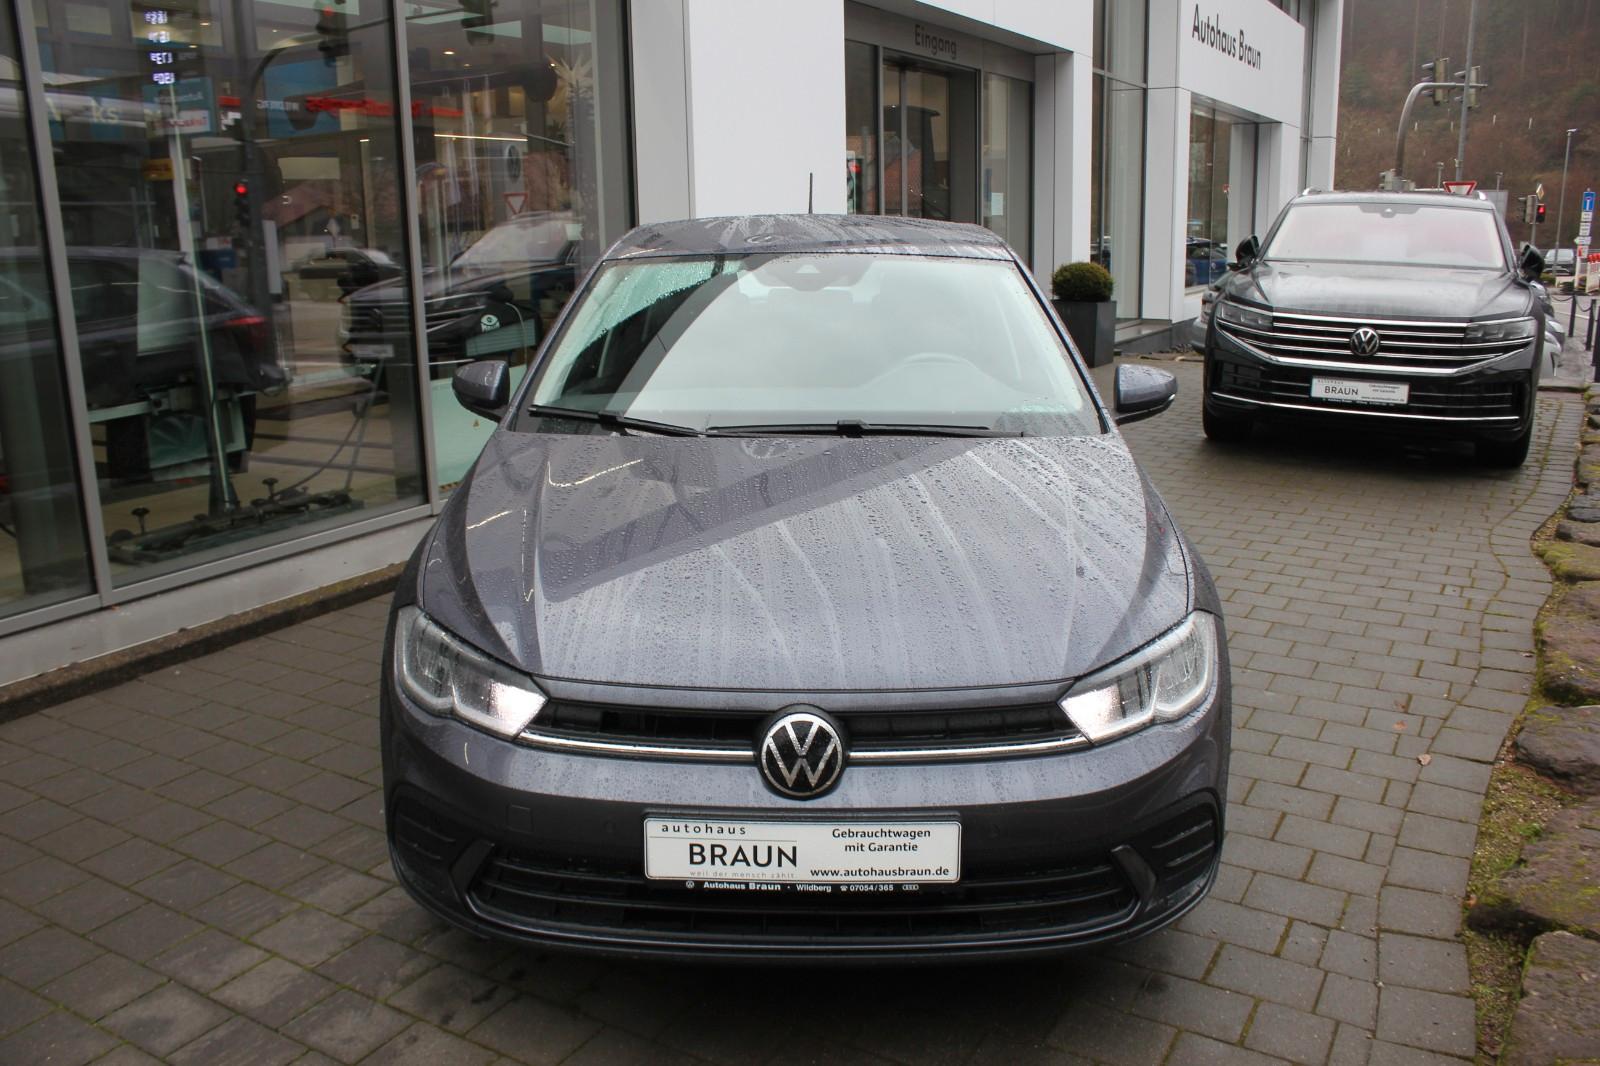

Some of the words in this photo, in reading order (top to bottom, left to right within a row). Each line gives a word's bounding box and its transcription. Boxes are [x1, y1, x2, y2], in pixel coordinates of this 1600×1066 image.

[915, 24, 957, 60] Eingang
[1192, 3, 1236, 58] Autohaus
[1239, 29, 1261, 70] Braun
[1324, 386, 1359, 395] BRAUN
[661, 823, 747, 835] autohaus
[832, 828, 931, 840] Gebrauchtwagen
[844, 843, 866, 852] mit
[868, 842, 918, 852] Garantie
[688, 843, 798, 868] BRAUN
[810, 866, 949, 877] www.autohausbraun.de
[703, 881, 746, 889] Autohaus
[796, 884, 832, 893] Wildberg
[849, 884, 894, 892] 07054/365
